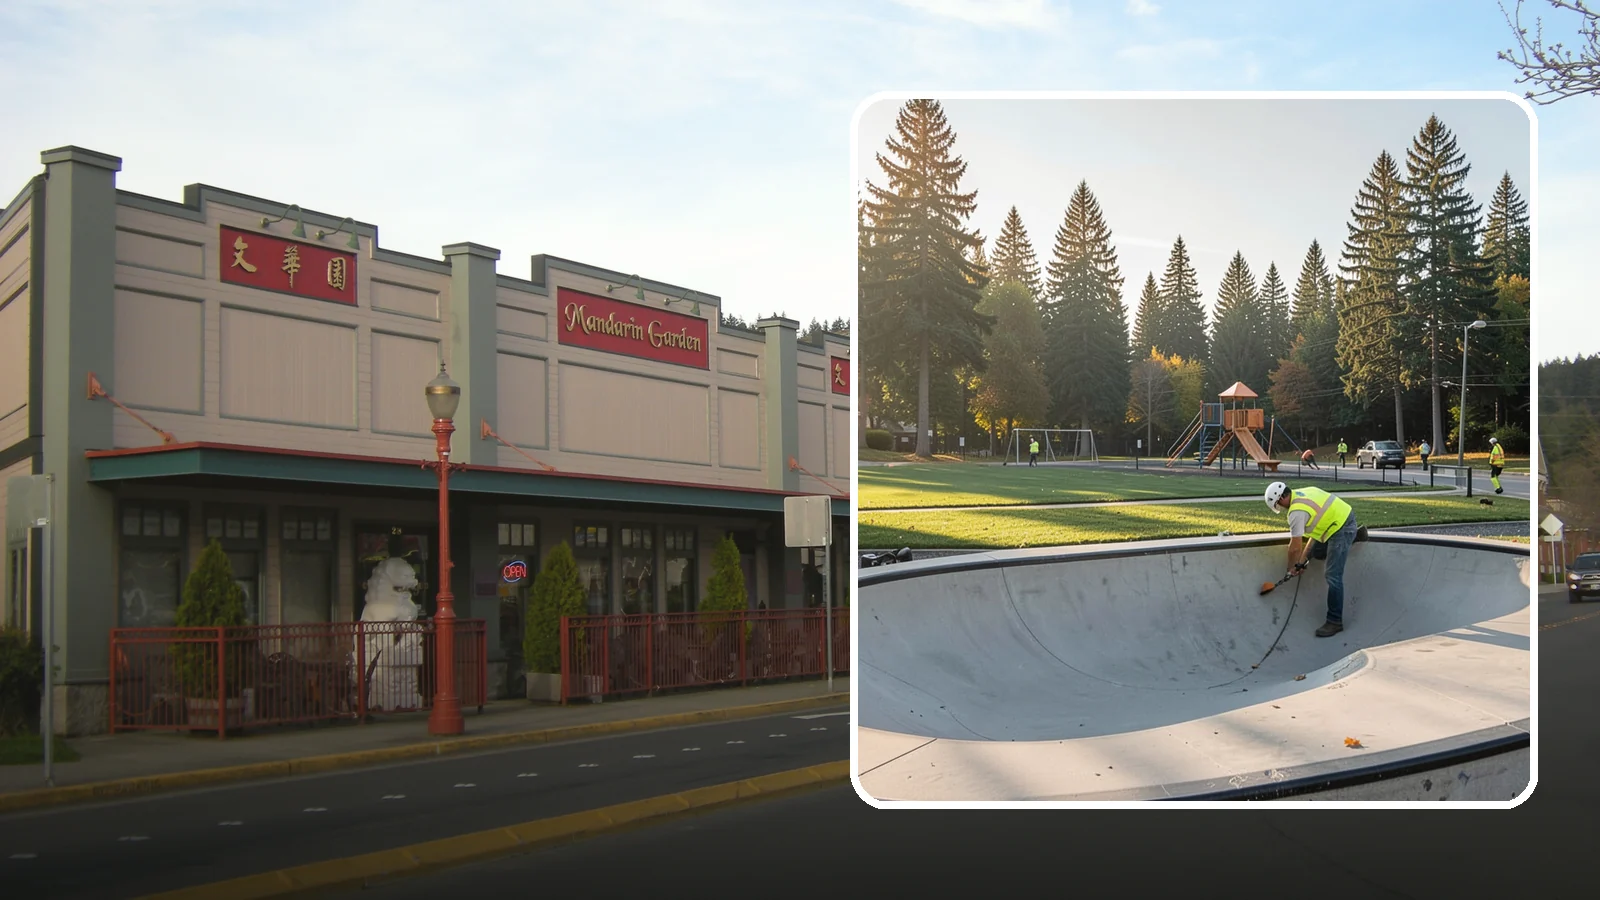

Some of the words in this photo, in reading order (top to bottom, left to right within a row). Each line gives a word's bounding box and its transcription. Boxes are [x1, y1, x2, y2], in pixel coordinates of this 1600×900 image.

[231, 236, 346, 291] 文華園
[565, 302, 644, 341] Mandarin
[648, 320, 701, 352] Garden
[503, 565, 527, 578] OPEN
